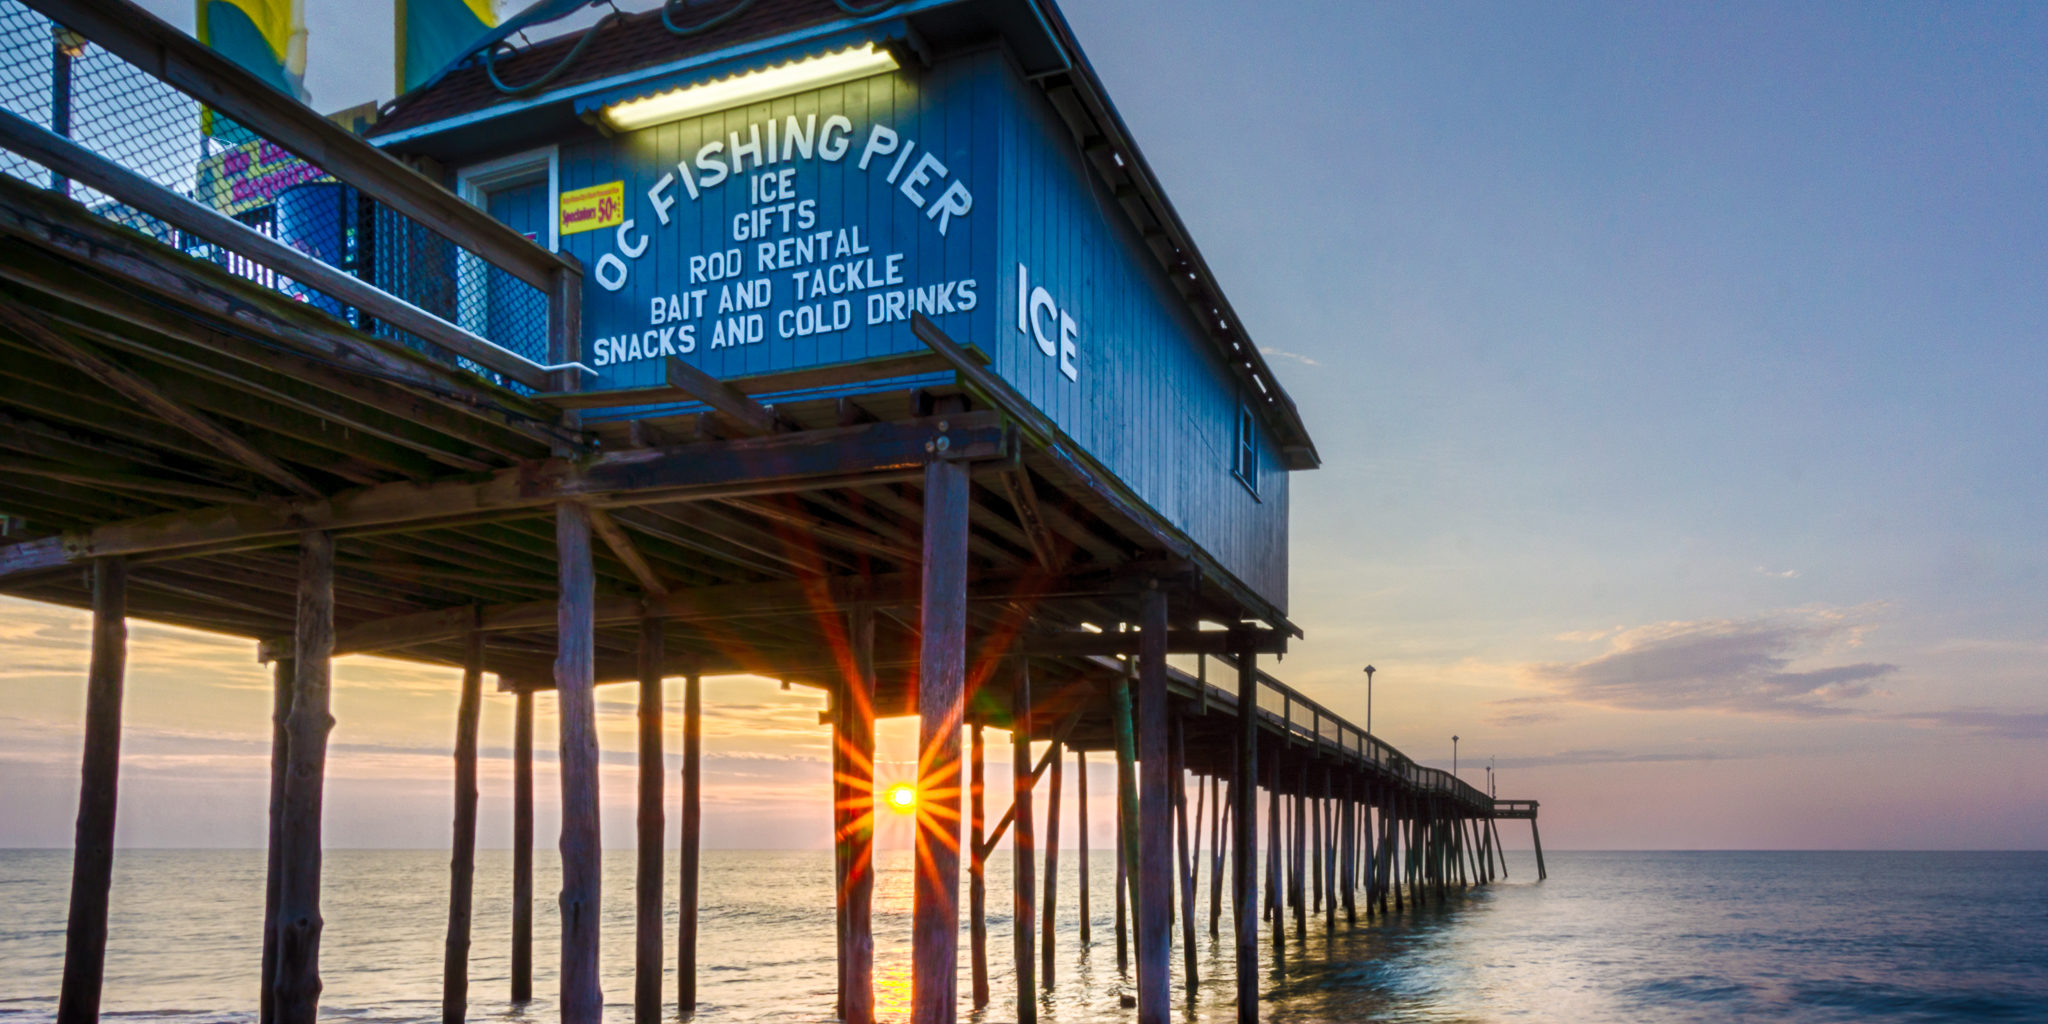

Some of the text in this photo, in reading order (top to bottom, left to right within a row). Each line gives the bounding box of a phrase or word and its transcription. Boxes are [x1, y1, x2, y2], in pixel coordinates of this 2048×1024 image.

[595, 114, 973, 291] OC FISHING PIER
[733, 199, 816, 241] GIFTS
[751, 168, 796, 205] ICE
[651, 253, 904, 325] BAIT AND TACKLE
[690, 225, 869, 284] ROD RENTAL
[594, 279, 977, 366] SNACKS AND COLD DRINKS
[1019, 262, 1078, 382] ICE
